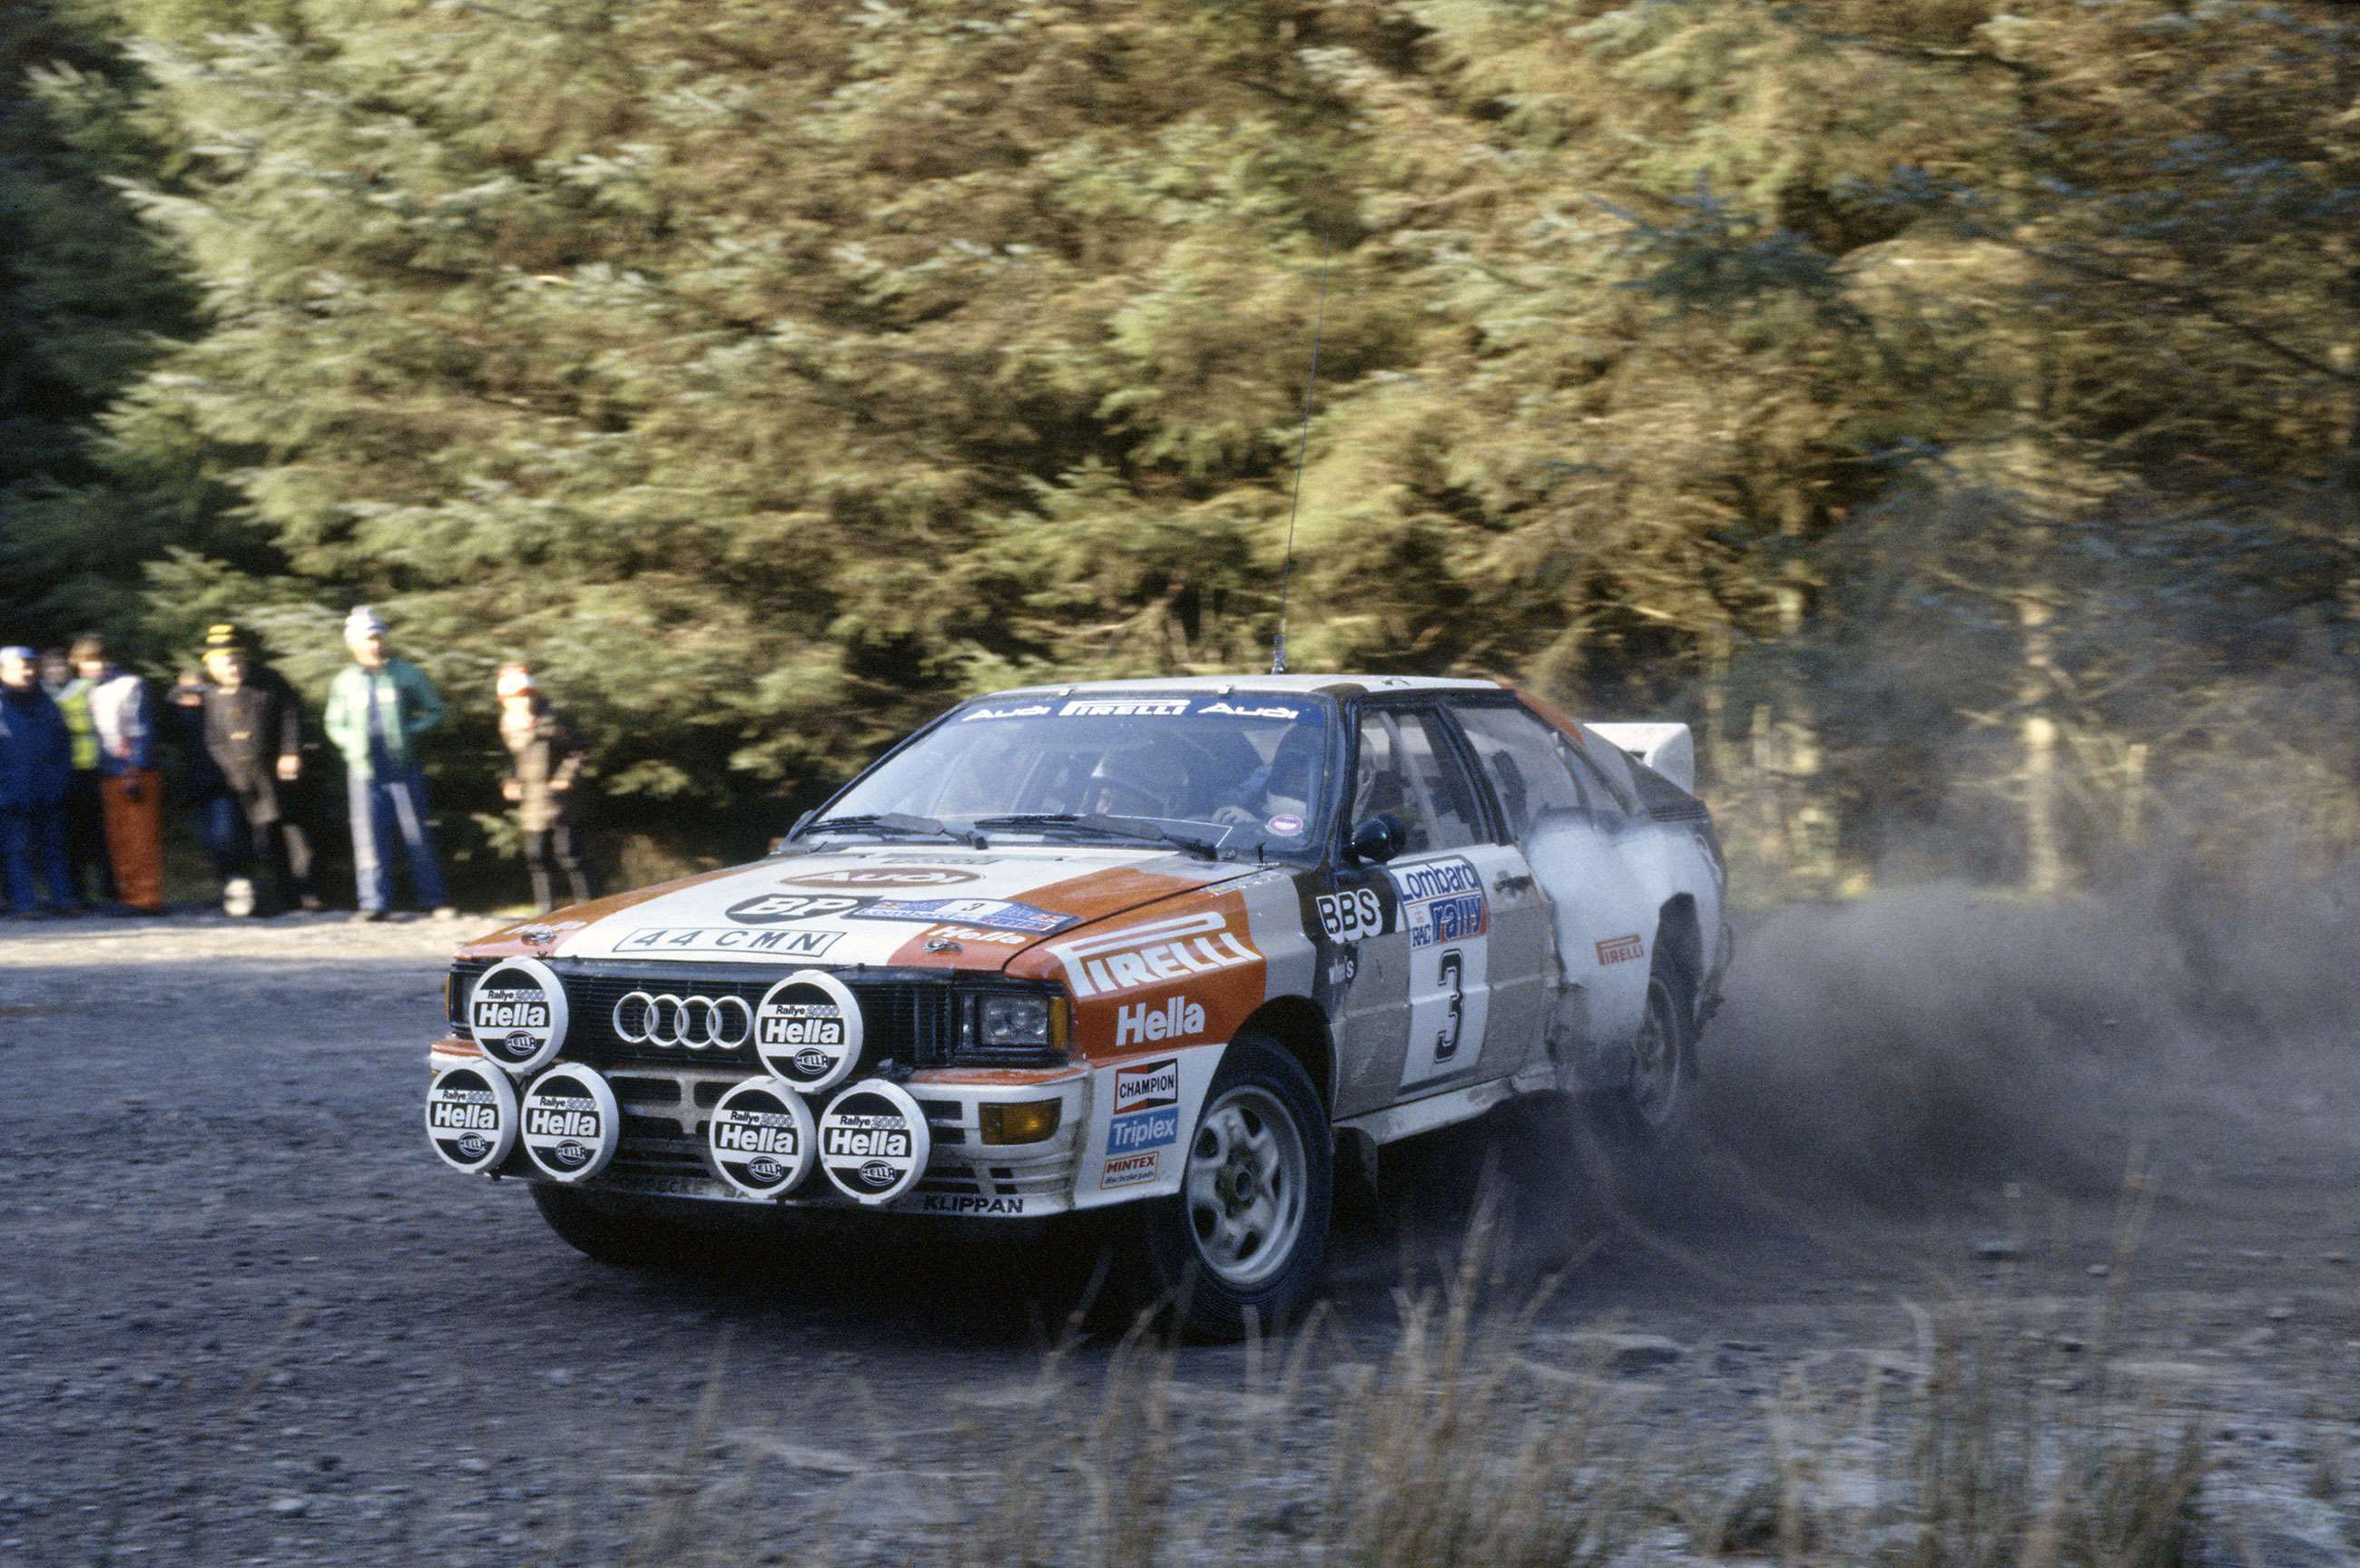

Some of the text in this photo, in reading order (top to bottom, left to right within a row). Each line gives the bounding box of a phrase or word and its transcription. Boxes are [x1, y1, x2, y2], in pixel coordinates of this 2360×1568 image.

[1058, 700, 1191, 716] PIRELLI
[1399, 864, 1479, 901] Lombard
[729, 897, 859, 916] BP
[1316, 888, 1382, 944] BBS
[1411, 896, 1482, 947] RAC rally
[633, 930, 828, 951] 44 CMN
[1596, 934, 1644, 966] PIRELLI
[1045, 911, 1264, 998] PIRELLI
[488, 990, 515, 1001] Rallye
[1434, 947, 1464, 1063] 3
[478, 1003, 546, 1026] Hella
[776, 1004, 806, 1016] Rallye
[1116, 995, 1205, 1046] Hella
[765, 1018, 840, 1044] Hella
[442, 1090, 467, 1102] Rallye
[1119, 1073, 1175, 1098] CHAMPION
[539, 1096, 565, 1108] Rallye
[434, 1102, 496, 1129] Hella
[530, 1110, 596, 1136] Hella
[730, 1111, 760, 1124] Rallye
[840, 1115, 870, 1127] Rallye
[720, 1123, 794, 1153] Hella
[830, 1129, 906, 1156] Hella
[1112, 1117, 1175, 1147] Triplex
[1106, 1154, 1155, 1172] MINTEX
[922, 1195, 1024, 1214] KLIPPAN
